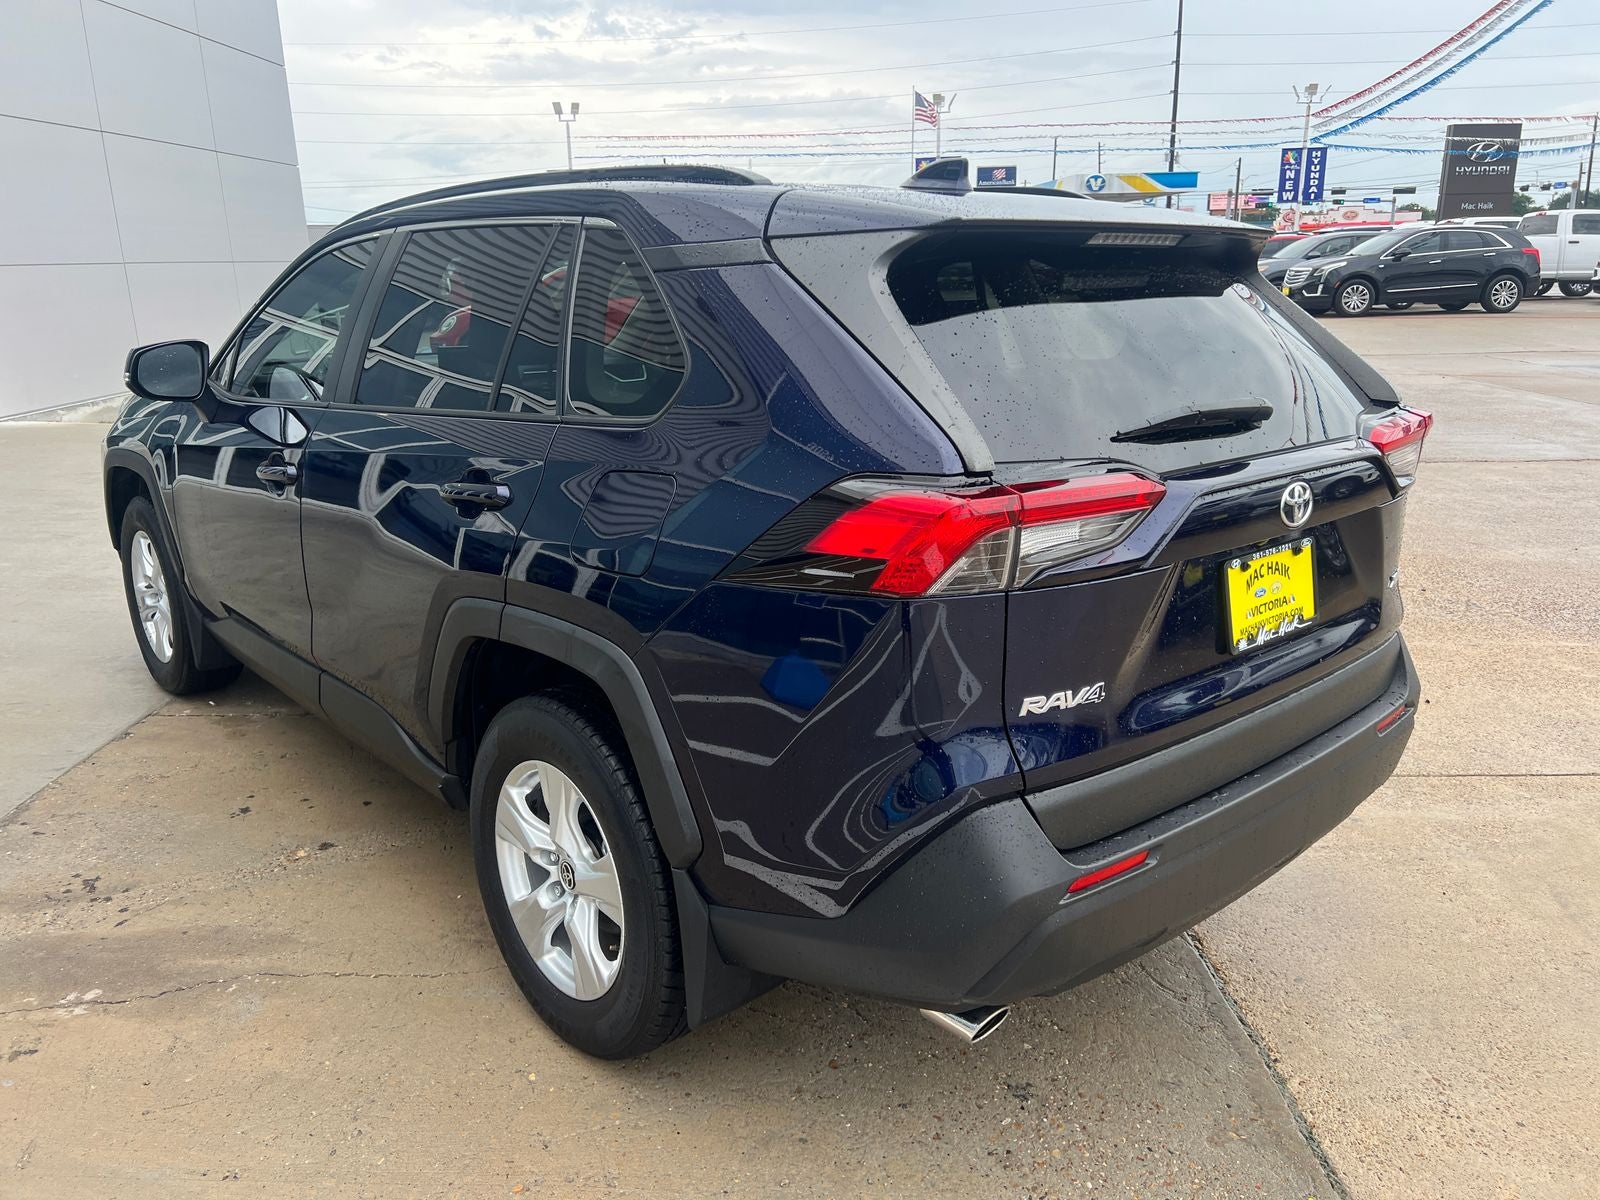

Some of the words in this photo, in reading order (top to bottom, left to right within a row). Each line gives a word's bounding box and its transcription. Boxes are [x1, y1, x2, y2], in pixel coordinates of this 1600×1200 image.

[1282, 170, 1295, 201] NEW
[1308, 150, 1321, 199] HYUNDAI
[1455, 165, 1510, 175] HYUNDAI
[1461, 202, 1476, 210] Mac
[1477, 201, 1494, 210] Haik
[1246, 563, 1265, 594] MAC
[1266, 561, 1291, 580] HAIK
[1250, 596, 1289, 618] VICTORIA
[1256, 625, 1279, 646] Mac
[1278, 615, 1305, 637] Haik
[1018, 682, 1106, 718] RAV4
